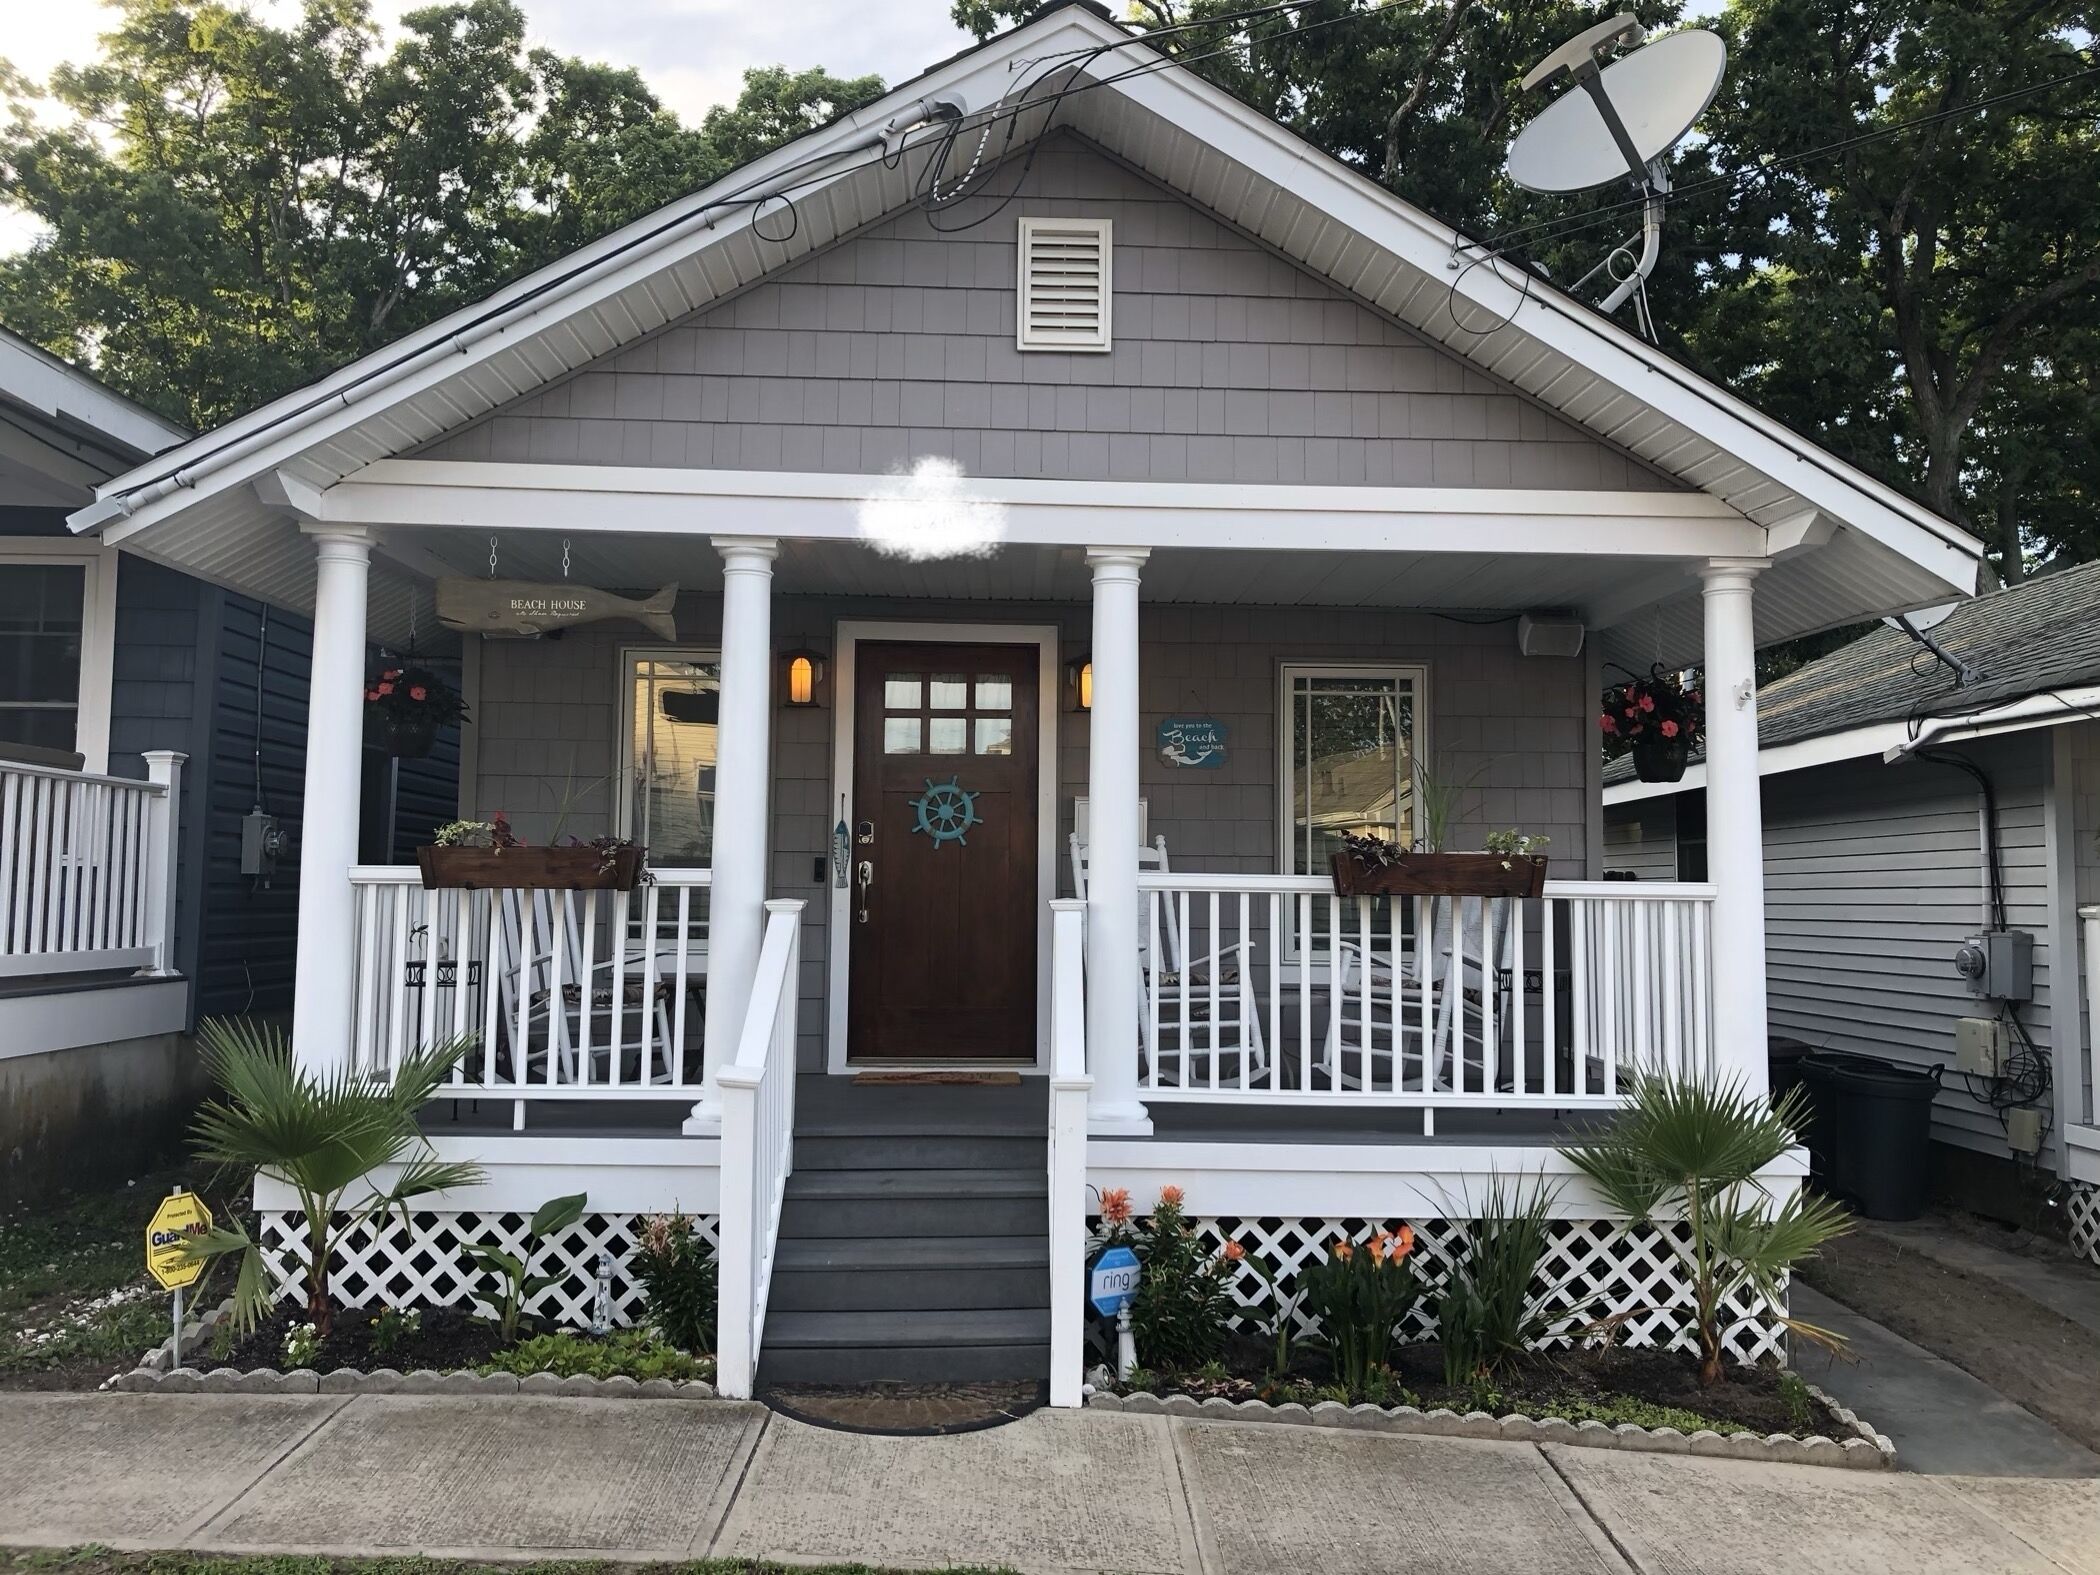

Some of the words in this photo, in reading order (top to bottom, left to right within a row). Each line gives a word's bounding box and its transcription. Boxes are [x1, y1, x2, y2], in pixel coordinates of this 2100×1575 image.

[511, 599, 546, 610] BEACH
[550, 600, 587, 610] HOUSE
[1162, 729, 1218, 745] Beach
[1103, 1271, 1130, 1291] ring
